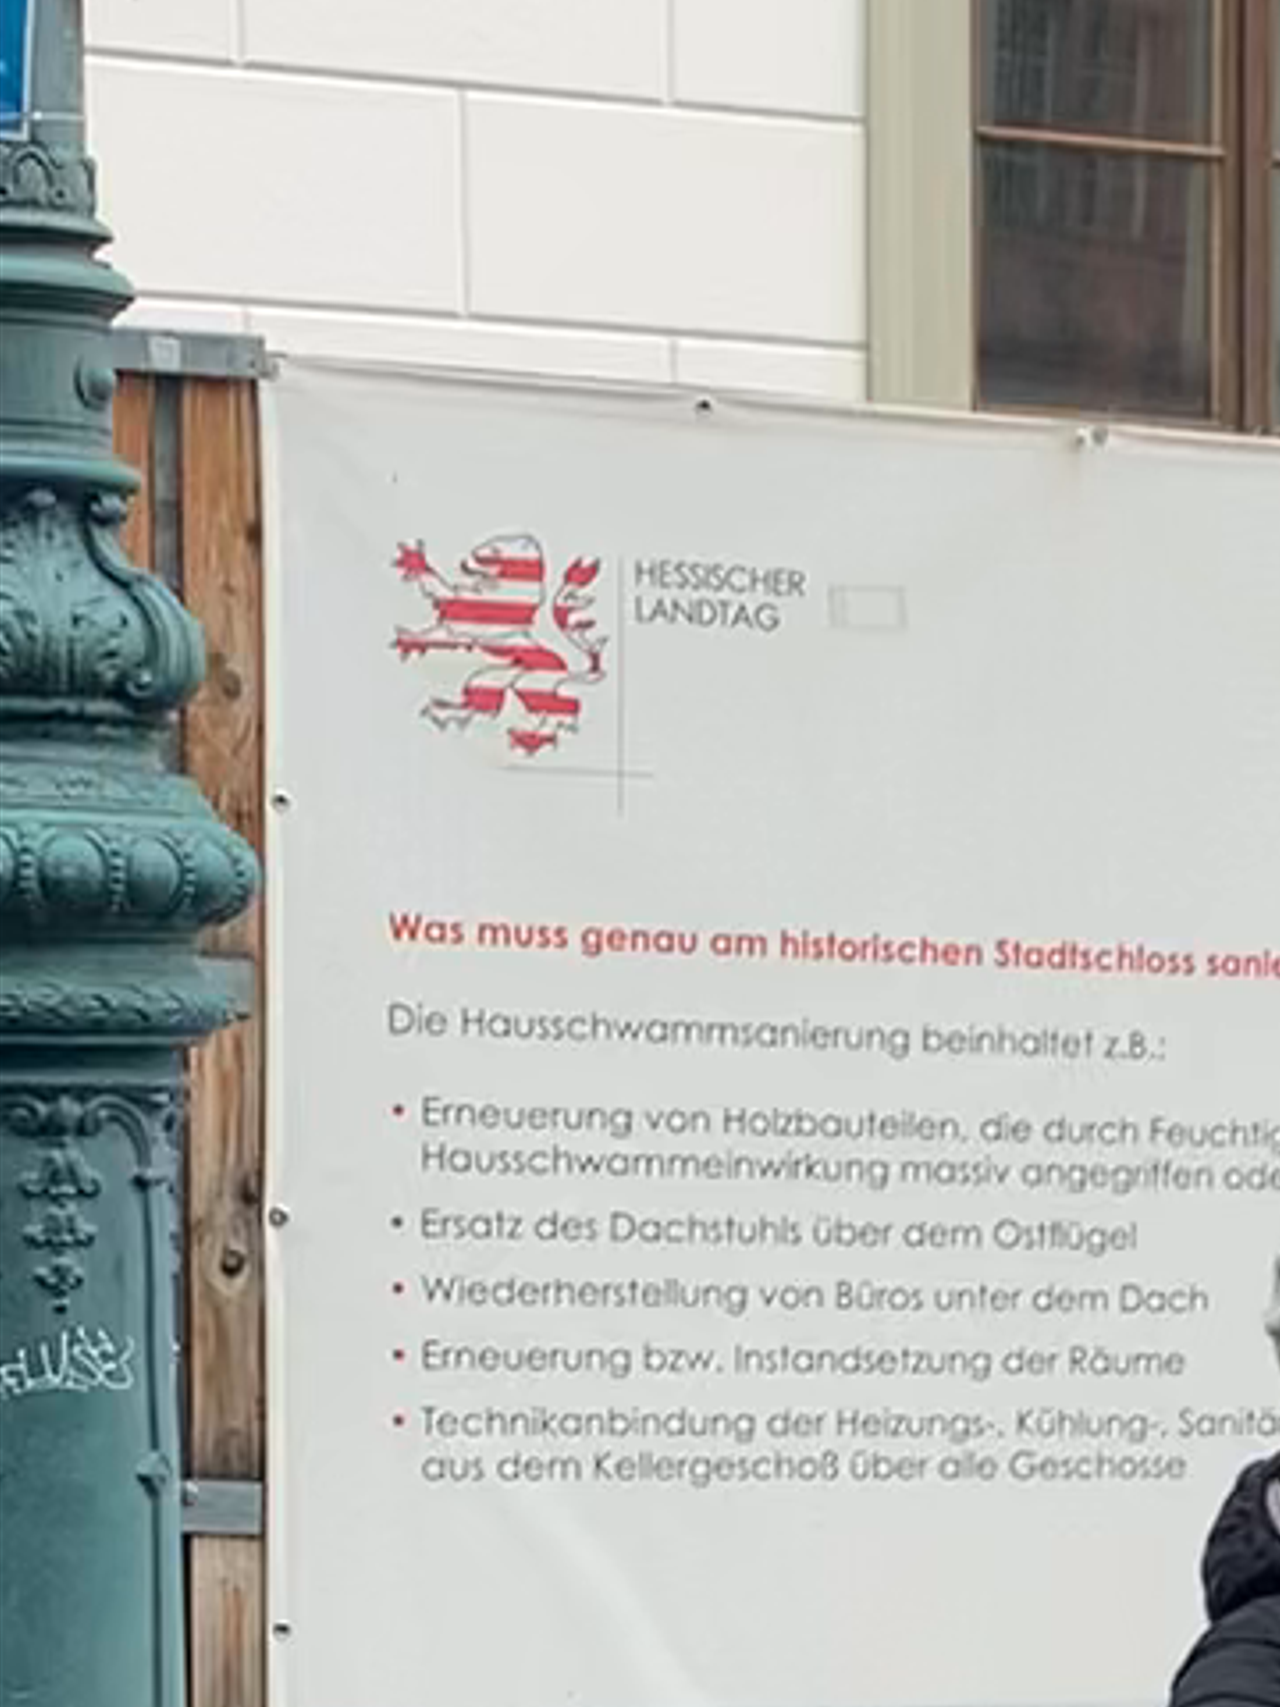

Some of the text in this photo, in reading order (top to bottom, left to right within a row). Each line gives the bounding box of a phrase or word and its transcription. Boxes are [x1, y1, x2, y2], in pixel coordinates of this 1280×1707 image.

[635, 560, 806, 597] HESSISCHER
[635, 597, 781, 631] LANDTAG
[388, 914, 464, 946] Was
[478, 922, 568, 950] muss
[581, 925, 697, 957] genau
[710, 933, 767, 956] am
[780, 930, 981, 967] historischen
[994, 940, 1196, 975] Stadtschloss
[387, 1003, 447, 1037] Die
[461, 1007, 910, 1059] Hausschwammsanierung
[922, 1022, 1094, 1058] beinhaltet
[422, 1097, 632, 1137] Erneuerung
[645, 1109, 709, 1133] von
[723, 1105, 968, 1143] Holzbauteilen,
[980, 1111, 1031, 1143] die
[1044, 1118, 1138, 1146] durch
[422, 1143, 889, 1190] Hausschwammeinwirkung
[900, 1155, 1010, 1183] massiv
[1022, 1161, 1213, 1197] angegriffen
[421, 1210, 1137, 1255] Ersatz des Dachstuhls über dem Ostflügel
[422, 1275, 1208, 1316] Wiederherstellung von Büros unter dem Dach
[422, 1340, 1185, 1381] Erneuerung bzw. Instandsetzung der Räume
[422, 1406, 755, 1445] Technikanbindung
[767, 1407, 825, 1438] der
[422, 1448, 1186, 1488] aus dem Kellergeschoß über alle Geschosse
